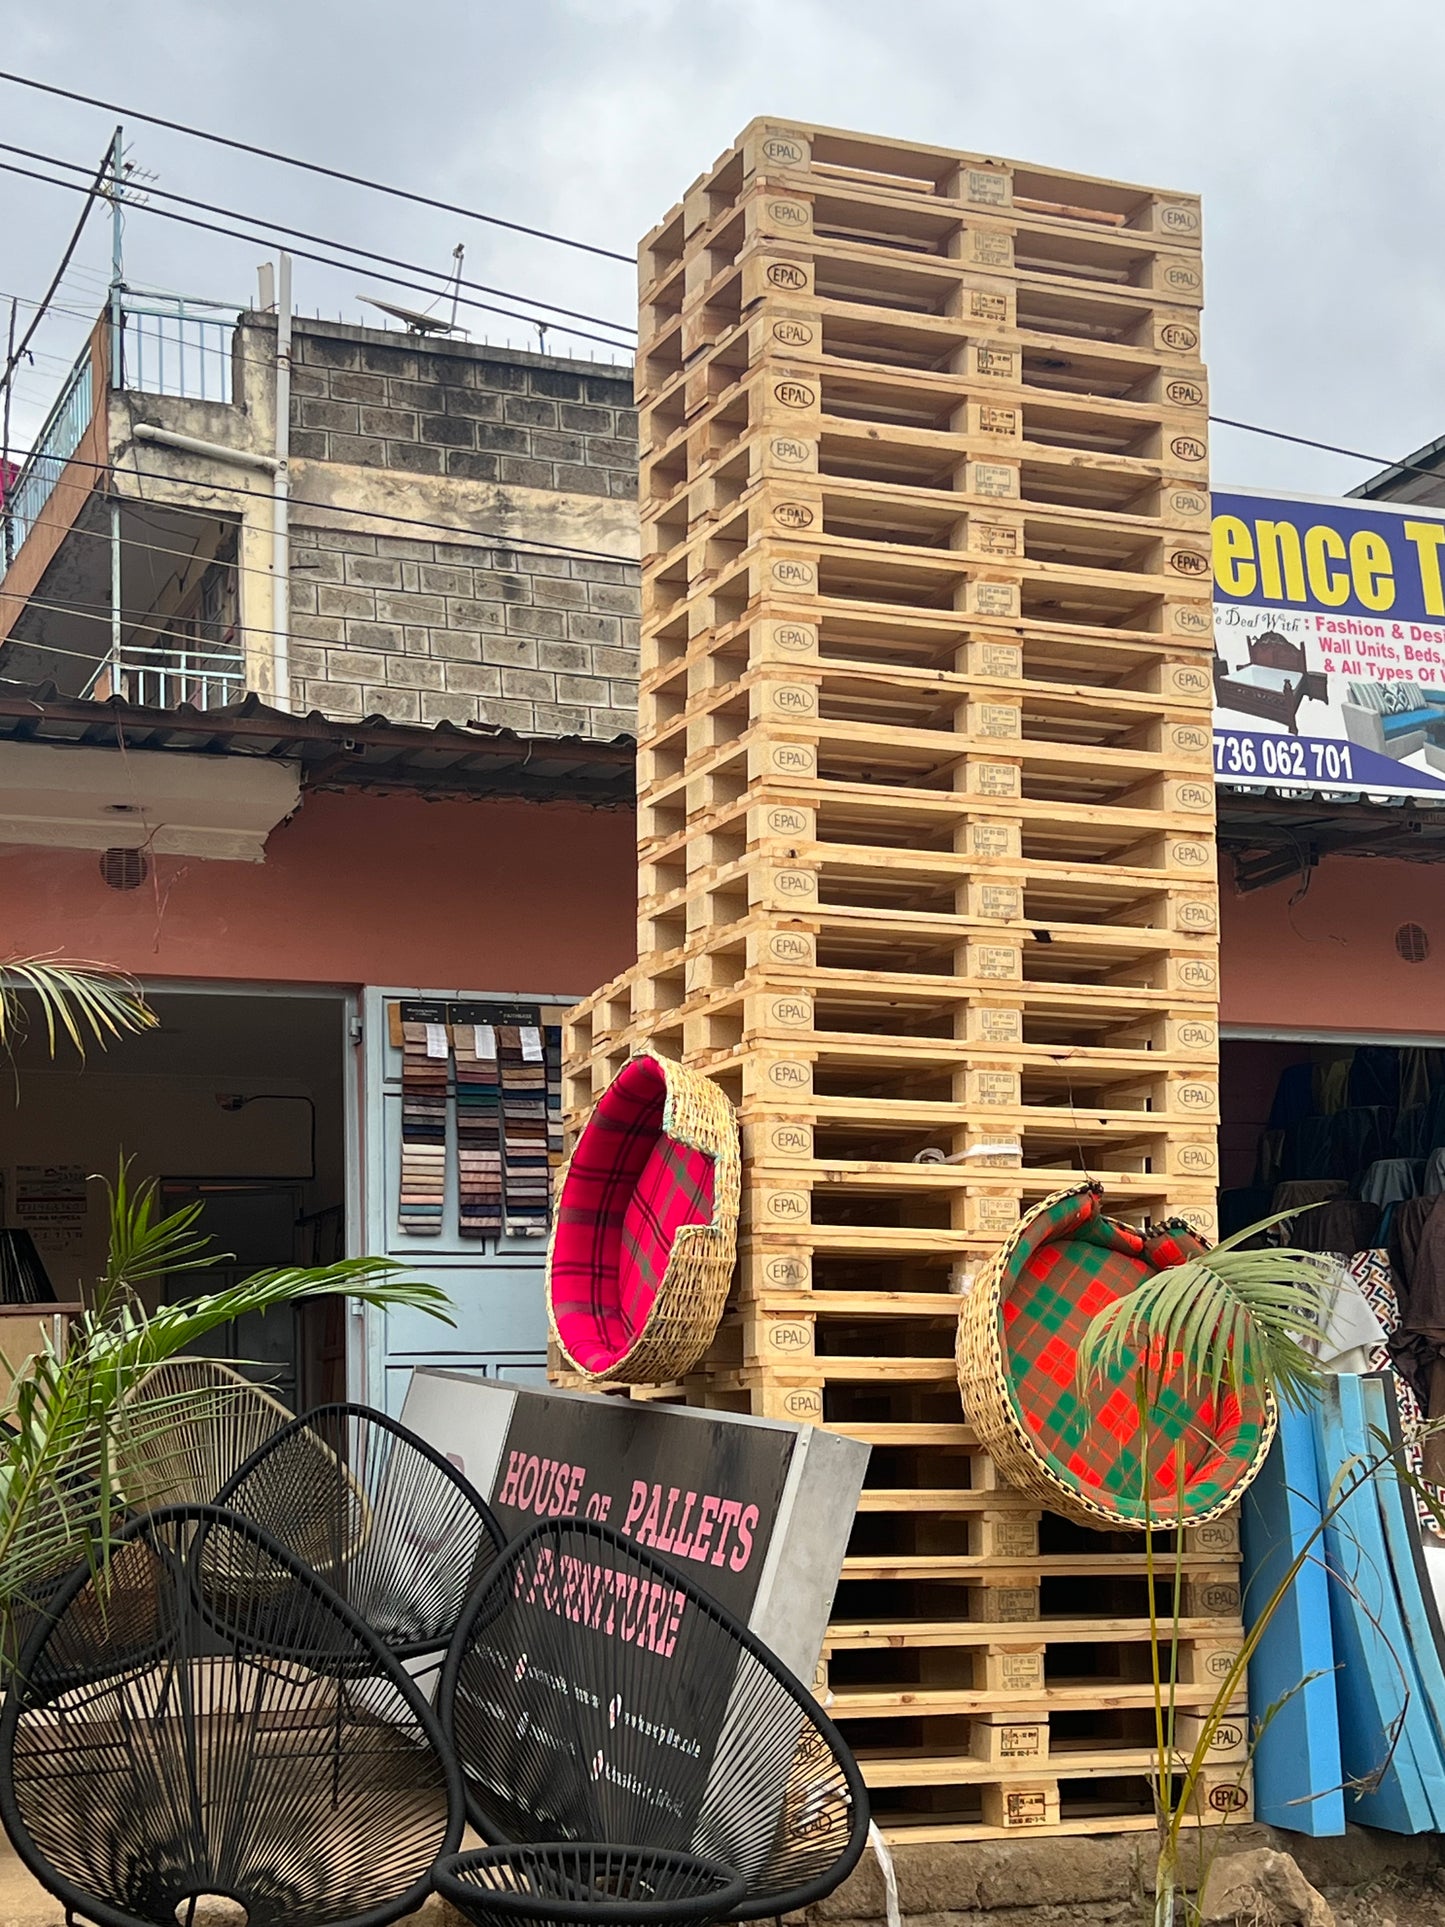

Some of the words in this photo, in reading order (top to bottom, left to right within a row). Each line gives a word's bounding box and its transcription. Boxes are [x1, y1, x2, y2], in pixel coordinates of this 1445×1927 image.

[769, 142, 802, 159] EPAL
[774, 204, 807, 222] EPAL
[1167, 213, 1193, 228] EPAL
[773, 267, 806, 285] EPAL
[1170, 271, 1196, 286] EPAL
[778, 326, 811, 343] EPAL
[780, 387, 813, 405] EPAL
[1172, 386, 1198, 401] EPAL
[776, 442, 807, 460] EPAL
[1177, 442, 1202, 457] EPAL
[1176, 496, 1202, 512] EPAL
[1177, 555, 1202, 571] EPAL
[779, 565, 812, 582] EPAL
[1180, 611, 1207, 627] EPAL
[1226, 606, 1260, 628] Deal
[1261, 612, 1301, 632] With
[1315, 616, 1385, 638] Fashion
[1391, 623, 1405, 640] &
[779, 629, 813, 646] EPAL
[1318, 637, 1351, 655] Wall
[1356, 640, 1400, 663] Units,
[1324, 658, 1336, 673] &
[1341, 660, 1362, 675] All
[1366, 662, 1414, 682] Types
[1418, 667, 1435, 682] Of
[1178, 672, 1204, 687] EPAL
[779, 692, 813, 708] EPAL
[1178, 731, 1204, 746] EPAL
[778, 751, 812, 768] EPAL
[1262, 739, 1307, 776] 062
[1310, 743, 1353, 779] 701
[1182, 788, 1208, 804] EPAL
[773, 814, 806, 831] EPAL
[1179, 846, 1204, 862] EPAL
[779, 876, 814, 893] EPAL
[1185, 907, 1211, 923] EPAL
[776, 940, 809, 955] EPAL
[1184, 967, 1211, 982] EPAL
[778, 1004, 811, 1018] EPAL
[1183, 1029, 1210, 1042] EPAL
[775, 1067, 809, 1082] EPAL
[1183, 1089, 1210, 1104] EPAL
[777, 1132, 811, 1147] EPAL
[1183, 1151, 1210, 1165] EPAL
[773, 1198, 807, 1213] EPAL
[772, 1263, 806, 1279] EPAL
[774, 1329, 809, 1345] EPAL
[790, 1395, 822, 1411] EPAL
[499, 1450, 587, 1517] HOUSE
[584, 1492, 612, 1522] OF
[621, 1480, 760, 1573] PALLETS
[1201, 1529, 1229, 1543] EPAL
